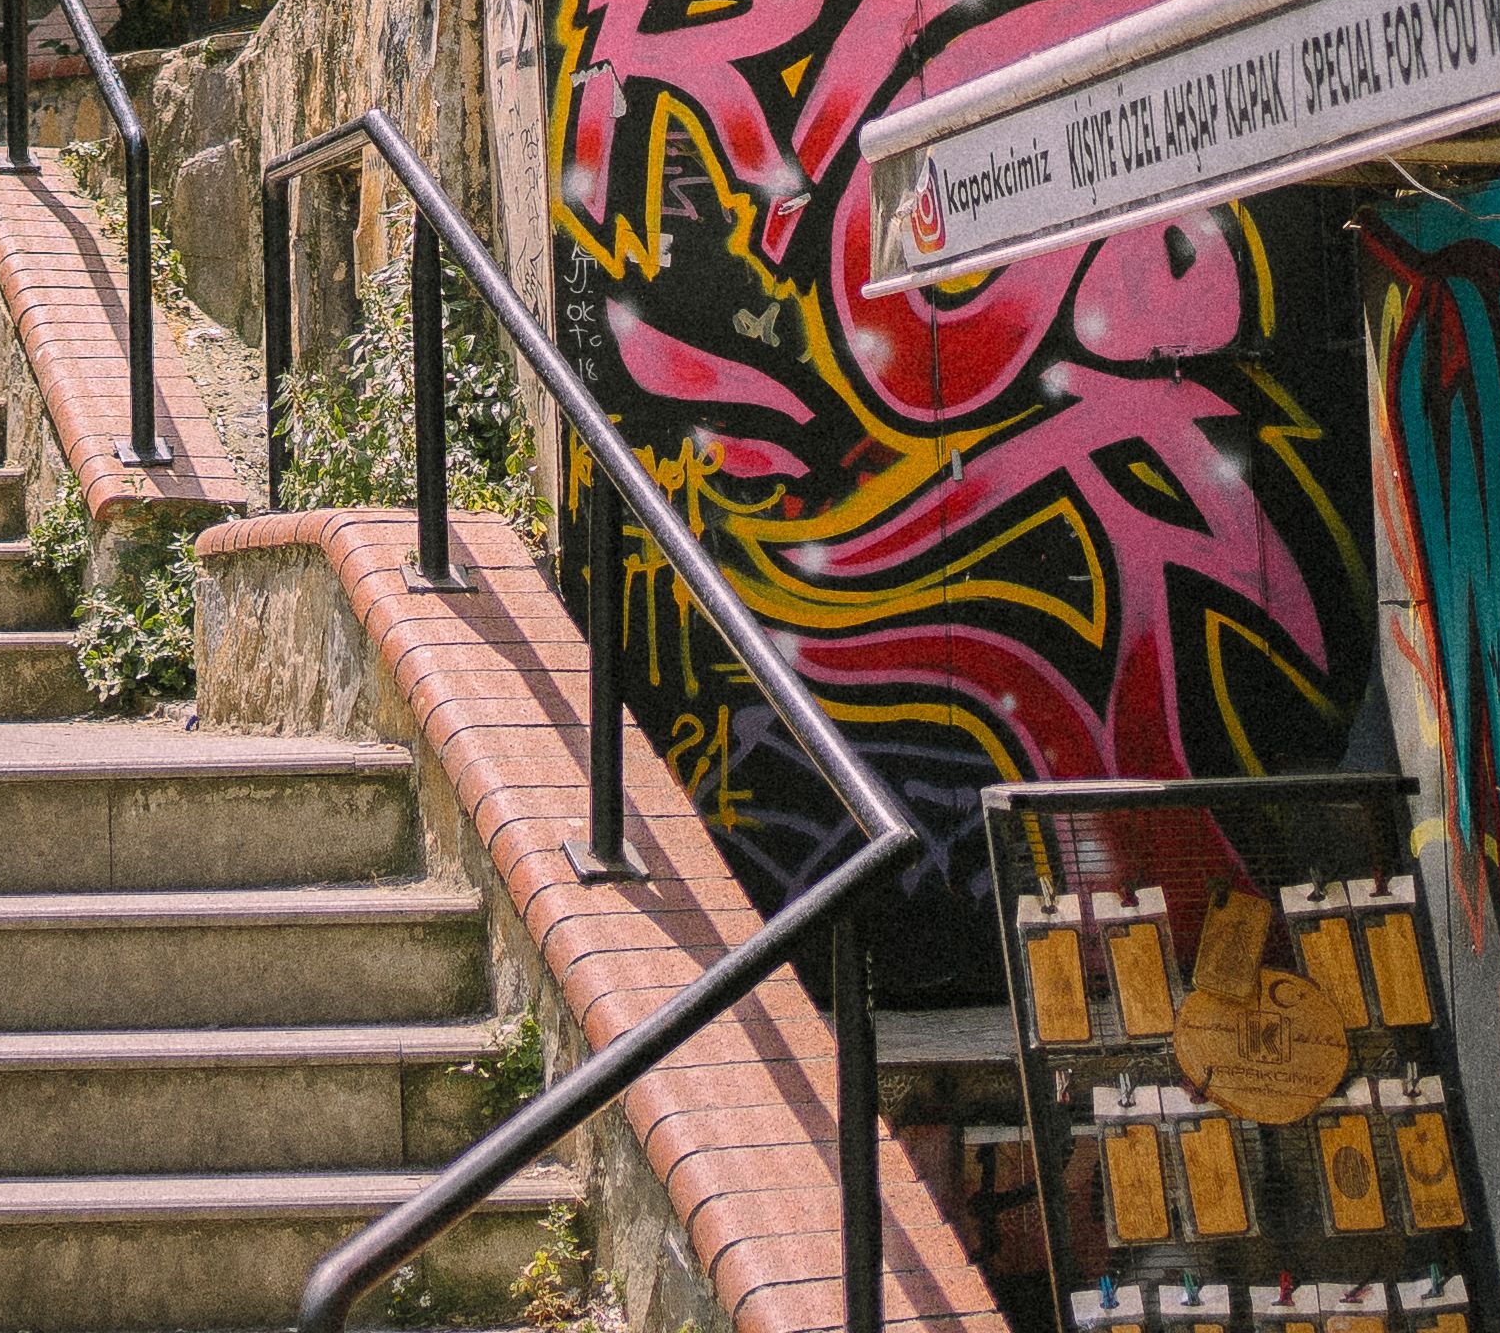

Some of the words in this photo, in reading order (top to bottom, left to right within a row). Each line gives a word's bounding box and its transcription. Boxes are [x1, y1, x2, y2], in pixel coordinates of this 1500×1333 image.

[944, 136, 1052, 223] kapakcimiz
[1066, 97, 1119, 209] KİŞİYE
[1117, 85, 1162, 173] ÖZEL
[1162, 71, 1221, 174] AHŞAP
[1222, 48, 1289, 137] KAPAK
[1300, 17, 1382, 116] SPECIAL
[1384, 1, 1429, 88] FOR
